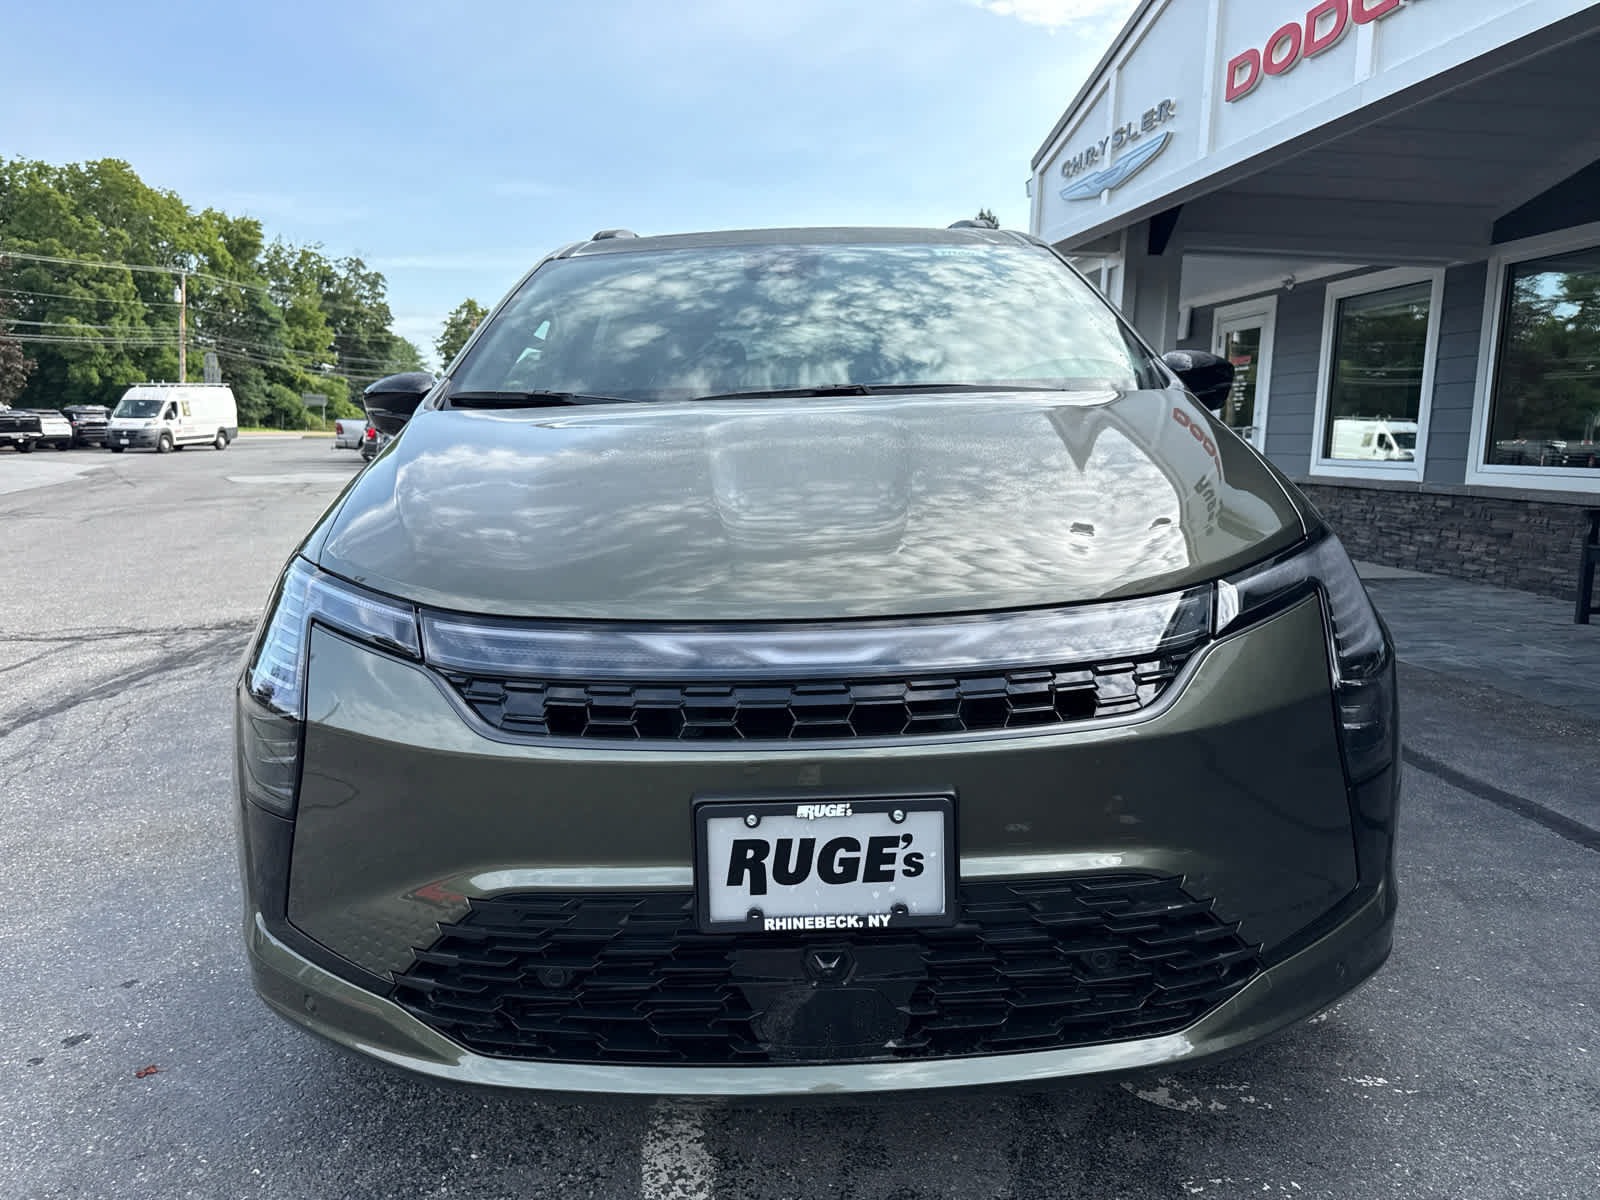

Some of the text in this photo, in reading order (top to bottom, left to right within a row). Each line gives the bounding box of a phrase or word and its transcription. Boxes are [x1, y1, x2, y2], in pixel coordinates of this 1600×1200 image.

[1061, 98, 1176, 178] CHRYSLER
[726, 833, 925, 896] RUGE's
[764, 914, 891, 931] RHINEBECK, NY
